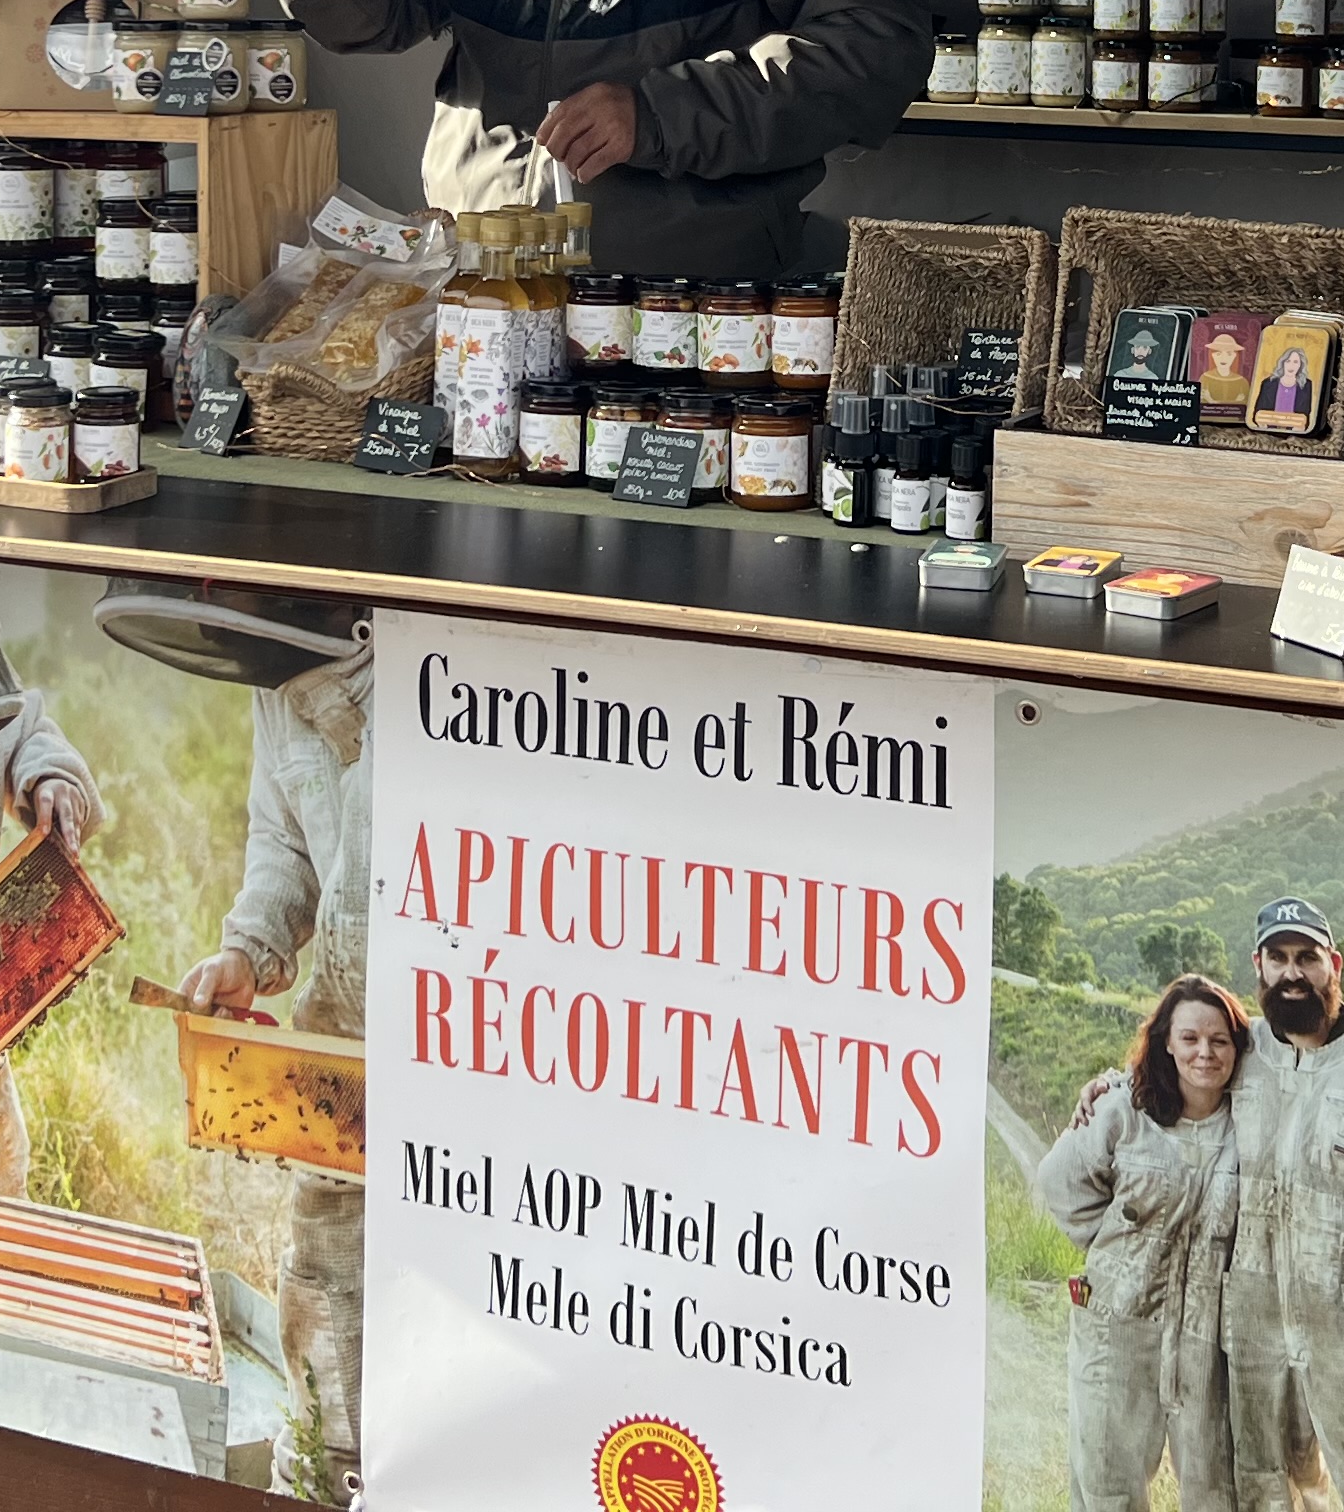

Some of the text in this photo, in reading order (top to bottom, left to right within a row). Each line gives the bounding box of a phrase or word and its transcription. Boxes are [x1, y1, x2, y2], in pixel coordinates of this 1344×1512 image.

[404, 443, 431, 462] 7€
[418, 651, 953, 810] Caroline et Rémi
[395, 820, 967, 1005] APICULTEURS
[411, 948, 943, 1159] RÉCOLTANTS
[402, 1140, 952, 1309] Miel AOP Miel de Corse
[486, 1253, 853, 1388] Mele di Corsica
[602, 1426, 713, 1512] APPELLATION D'ORIGINE PROTÉG
